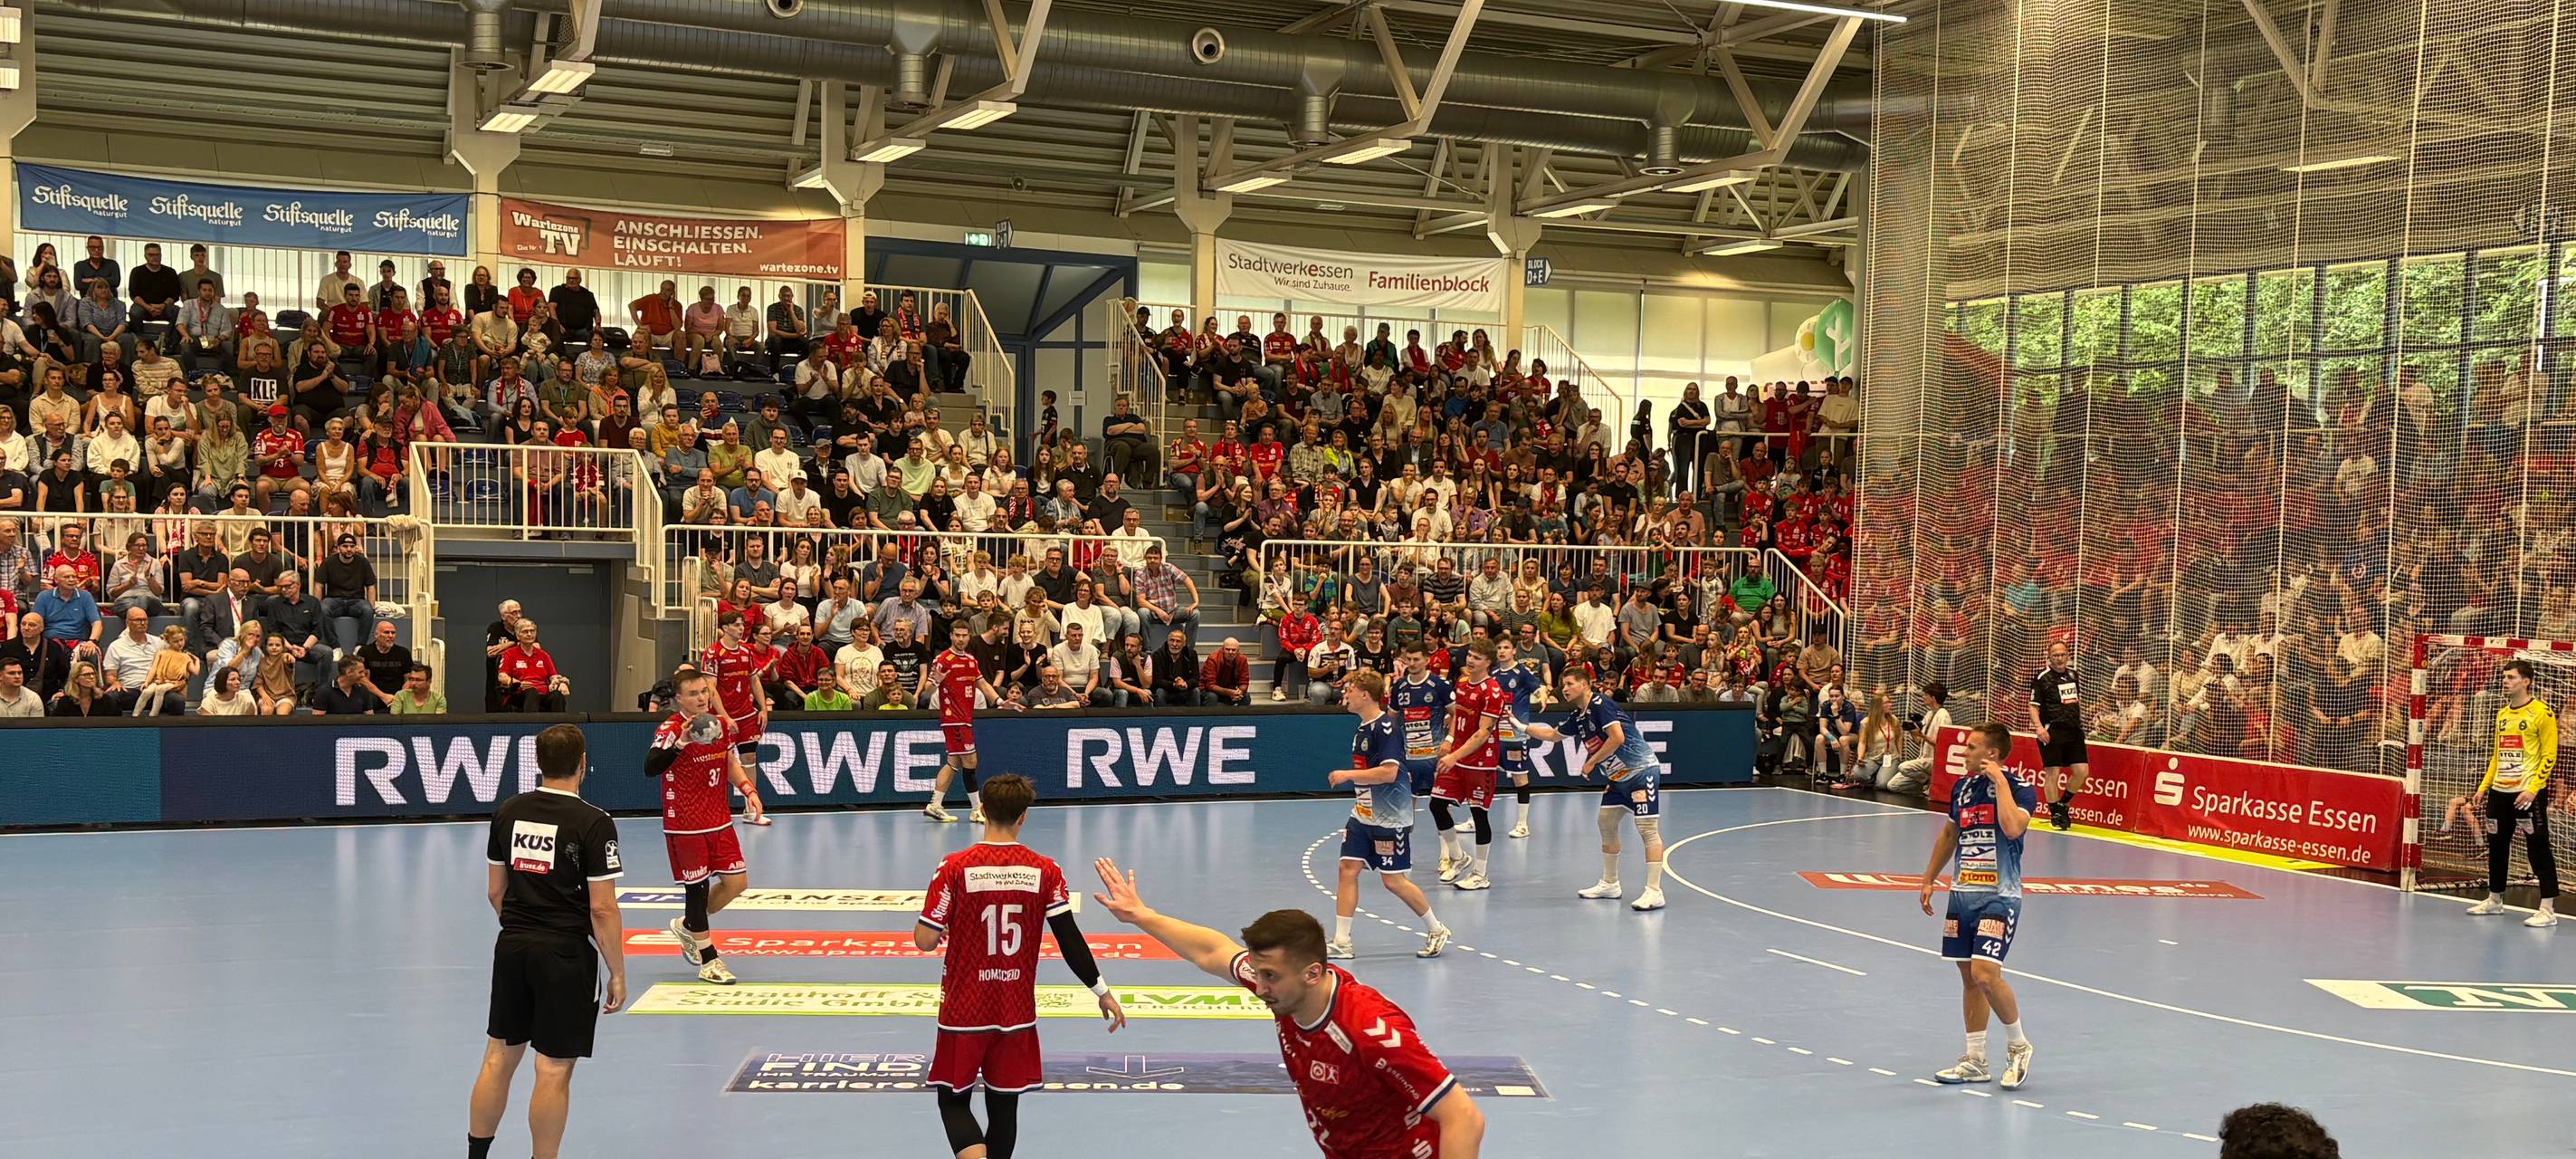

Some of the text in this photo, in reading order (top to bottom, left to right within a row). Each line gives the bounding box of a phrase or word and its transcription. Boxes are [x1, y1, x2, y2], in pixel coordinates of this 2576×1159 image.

[32, 184, 129, 213] Stiftsquelle
[148, 193, 243, 222] Stiftsquelle
[262, 200, 354, 229] Stiftsquelle
[372, 207, 460, 234] Stiftsquelle
[511, 211, 578, 234] Wartezone
[615, 219, 763, 240] ANSCHLIESSEN.
[539, 229, 580, 255] TV
[613, 236, 753, 254] EINSCHALTEN.
[614, 249, 682, 268] LÄUFT!
[759, 262, 839, 275] wartezone.tv
[1228, 253, 1490, 293] Stadtwerkessen Familienblock
[1274, 276, 1291, 289] Wir
[1292, 277, 1312, 290] sind
[1398, 692, 1411, 706] 23
[1066, 725, 1256, 789] RWE
[1636, 803, 1648, 815] 20
[2191, 785, 2376, 834] Sparkasse Essen
[2187, 824, 2371, 865] www.sparkasse-essen.de
[1381, 857, 1394, 867] 34
[980, 904, 1023, 957] 15
[1981, 940, 2001, 957] 42
[1121, 993, 1243, 1006] LVM
[759, 1062, 934, 1072] FIND
